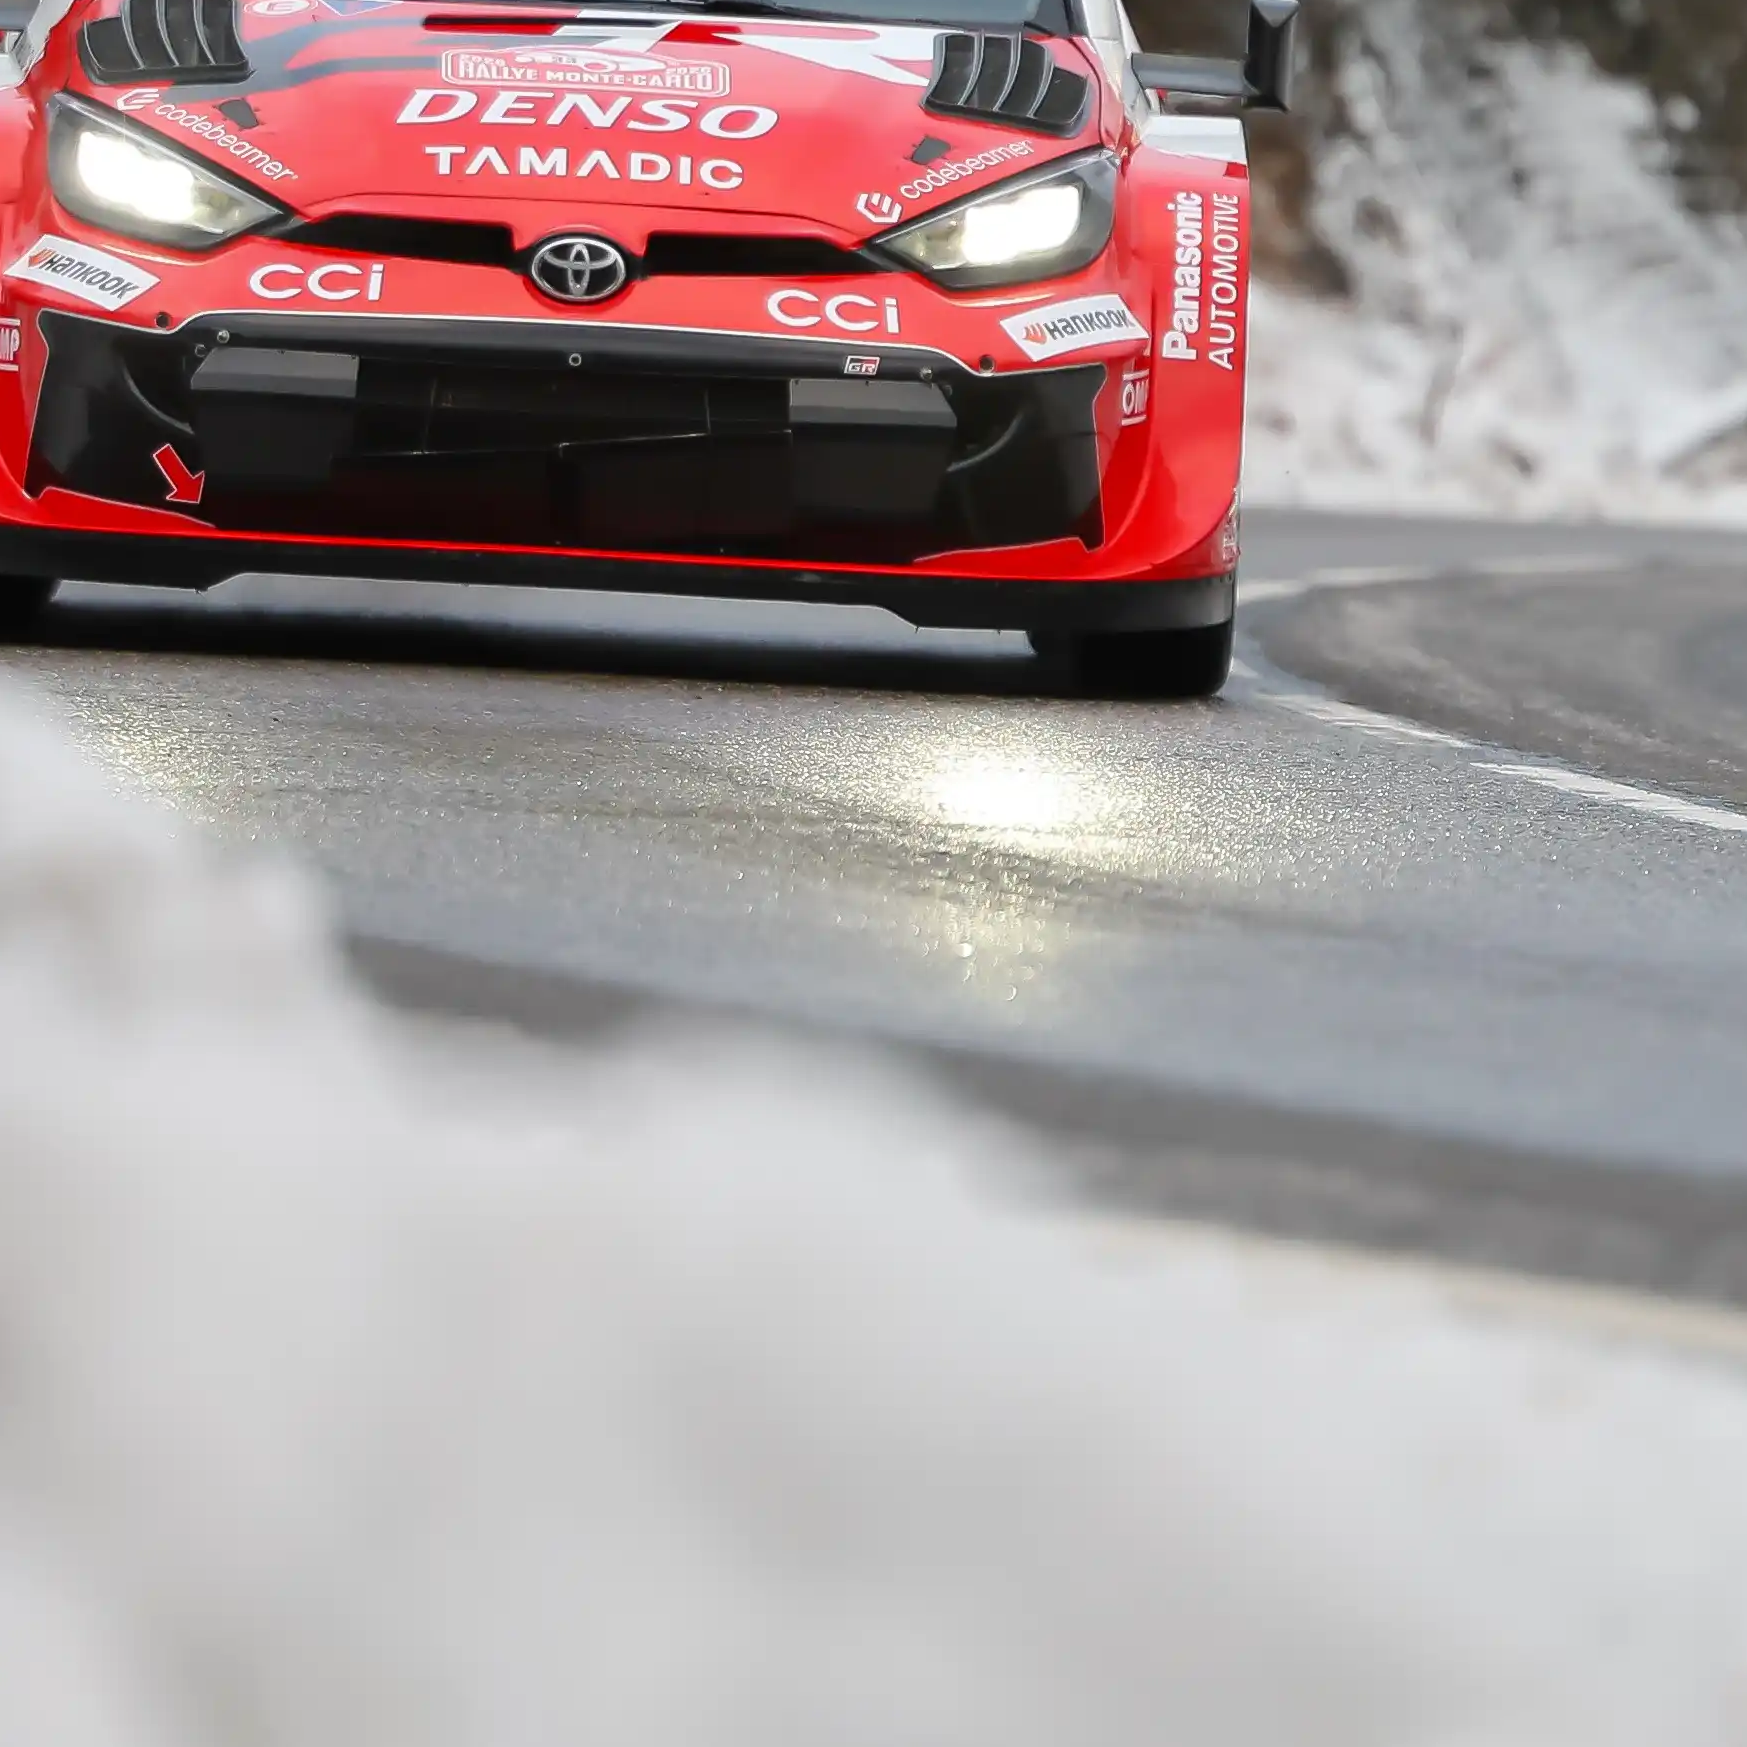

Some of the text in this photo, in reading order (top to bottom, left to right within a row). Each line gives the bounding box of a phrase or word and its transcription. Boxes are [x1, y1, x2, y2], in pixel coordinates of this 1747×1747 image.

[457, 60, 539, 81] RALLYE
[154, 103, 295, 182] codebeamer
[395, 88, 779, 140] DENSO
[424, 145, 745, 190] TAMADIC
[899, 138, 1035, 200] codebeamer
[1161, 190, 1204, 362] Panasonic
[1207, 191, 1241, 372] AUTOMOTIVE
[848, 362, 877, 374] GR
